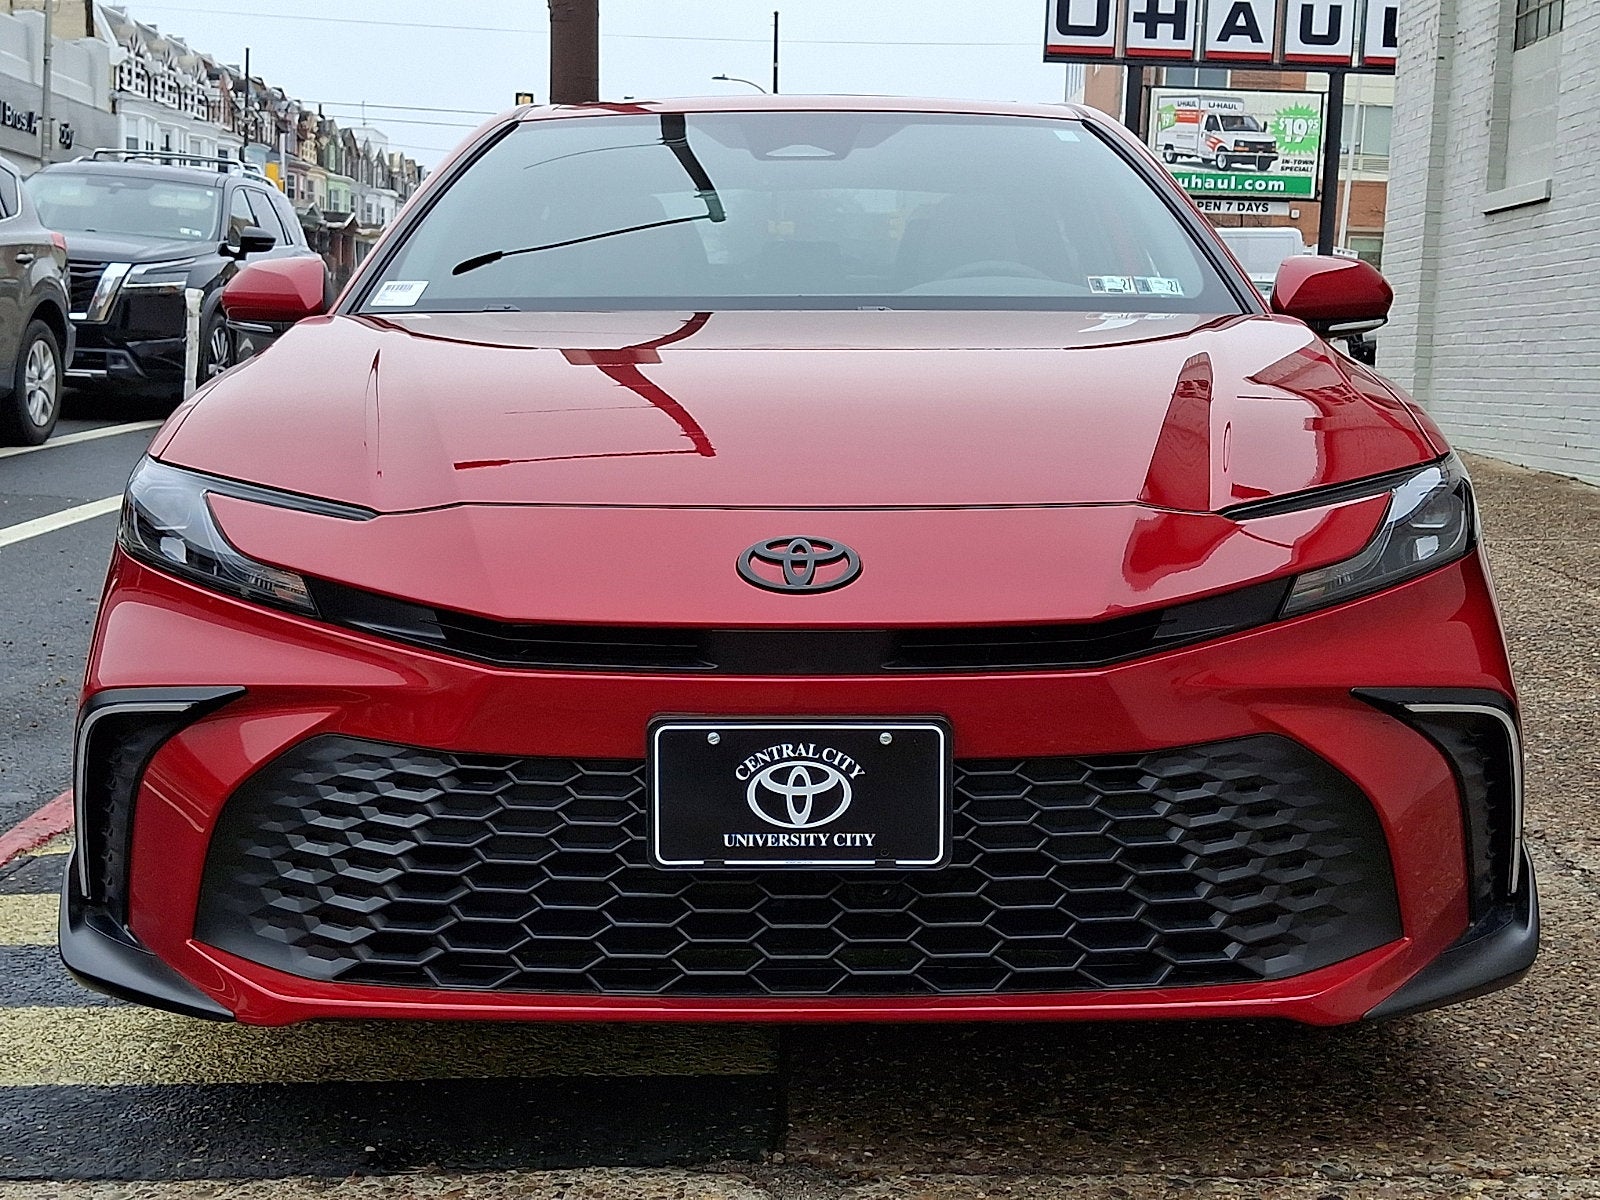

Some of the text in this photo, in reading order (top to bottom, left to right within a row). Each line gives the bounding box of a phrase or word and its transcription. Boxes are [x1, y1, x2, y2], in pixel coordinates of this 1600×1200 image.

[1208, 102, 1238, 110] U-HAUL
[1178, 175, 1285, 191] uhaul.com
[1196, 201, 1269, 213] PEN 7 DAYS
[735, 743, 866, 781] CENTRAL CITY
[723, 833, 876, 847] UNIVERSITY CITY
